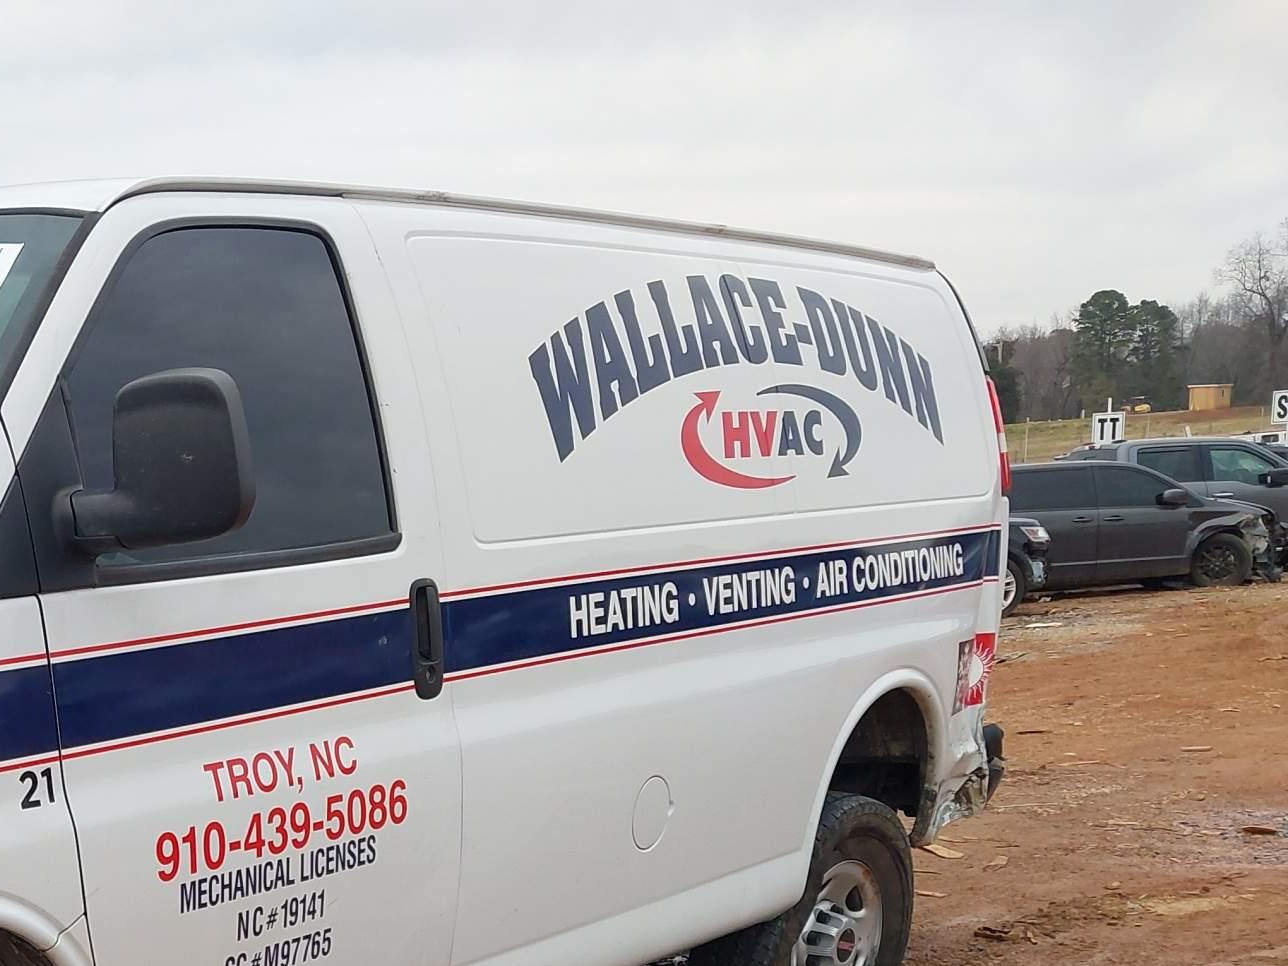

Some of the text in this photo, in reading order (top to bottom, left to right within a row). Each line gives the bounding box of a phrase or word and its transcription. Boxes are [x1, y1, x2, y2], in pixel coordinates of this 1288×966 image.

[528, 274, 945, 463] WALLACE-DUNN
[721, 410, 824, 459] HVAC
[1277, 395, 1288, 418] S
[569, 543, 964, 638] HEATING VENTING AIR CONDITIONING
[18, 767, 56, 809] 21
[203, 736, 359, 802] TROY, NC
[155, 779, 409, 882] 910-439-5086
[179, 834, 377, 913] MECHANICAL LICENSES
